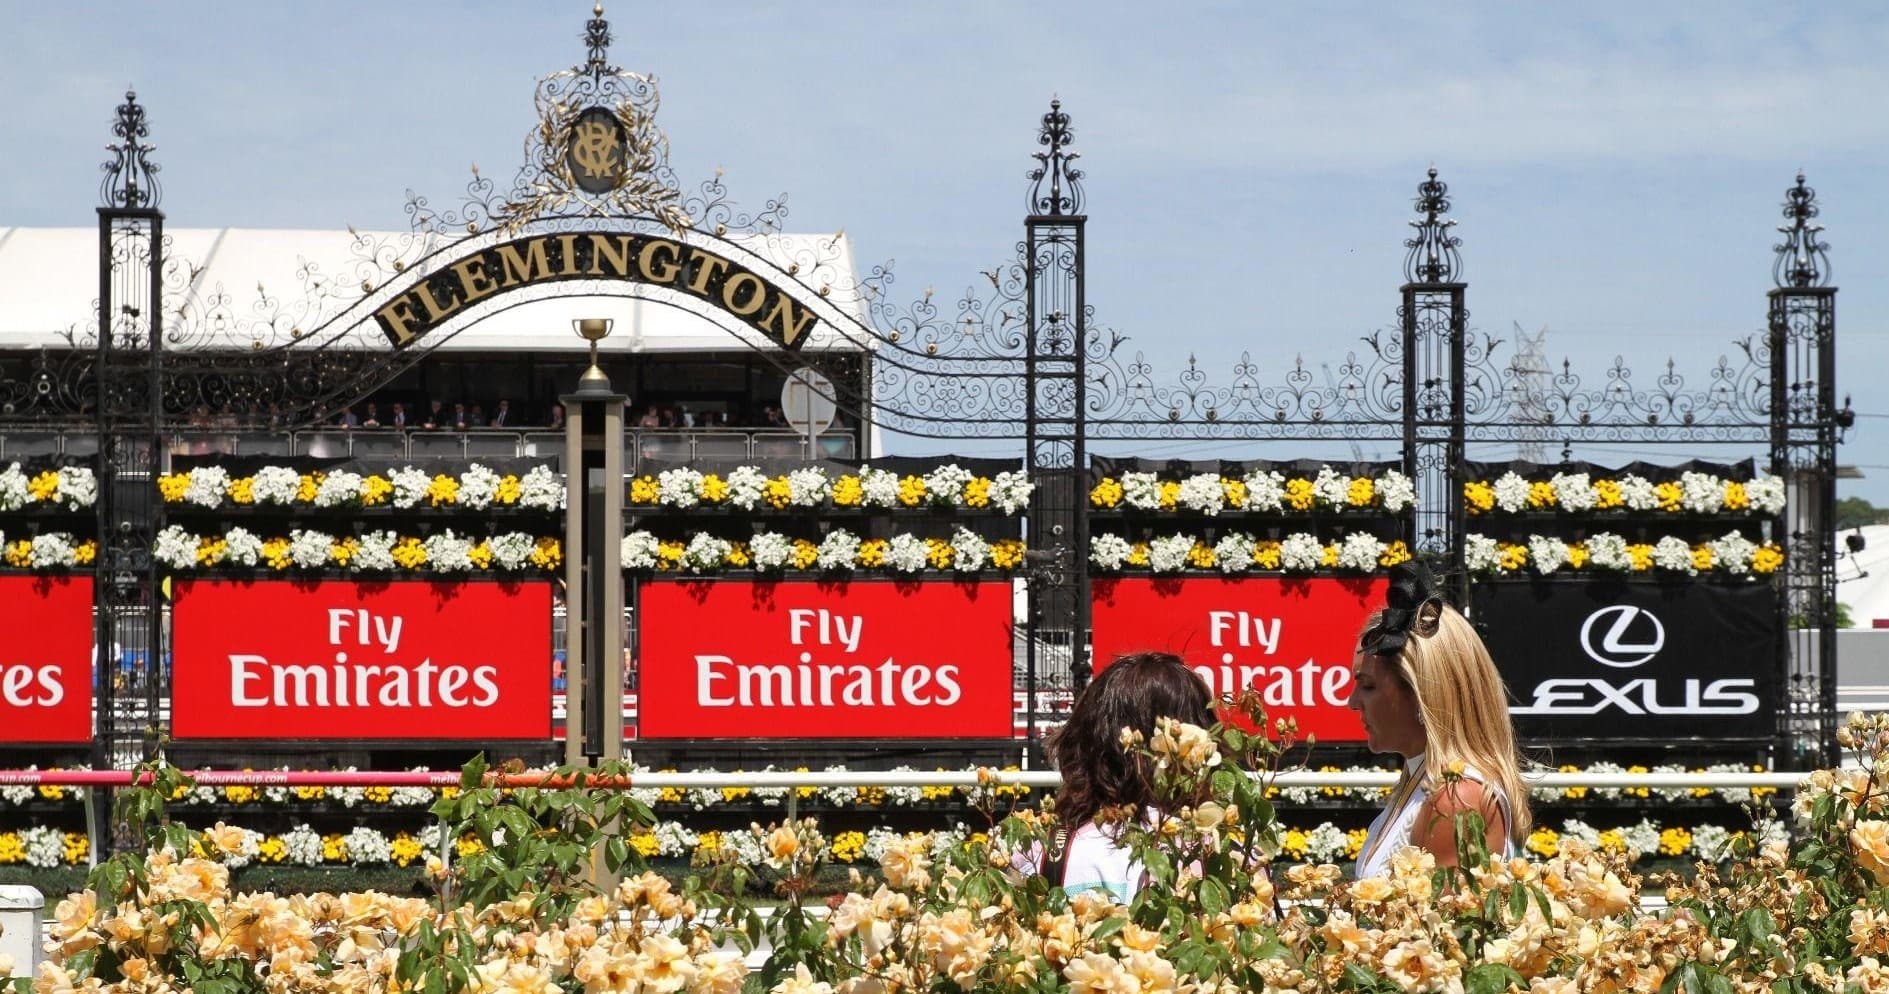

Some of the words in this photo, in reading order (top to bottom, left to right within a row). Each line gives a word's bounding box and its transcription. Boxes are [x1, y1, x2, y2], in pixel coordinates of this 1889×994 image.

[378, 234, 817, 346] FLEMINGTON
[328, 608, 403, 653] Fly
[789, 608, 863, 653] Fly
[1209, 611, 1282, 654] Fly
[0, 664, 64, 707] es
[228, 652, 499, 707] Emirates
[694, 652, 961, 707] Emirates
[1192, 653, 1350, 707] irate
[195, 771, 288, 785] elbournecup.com
